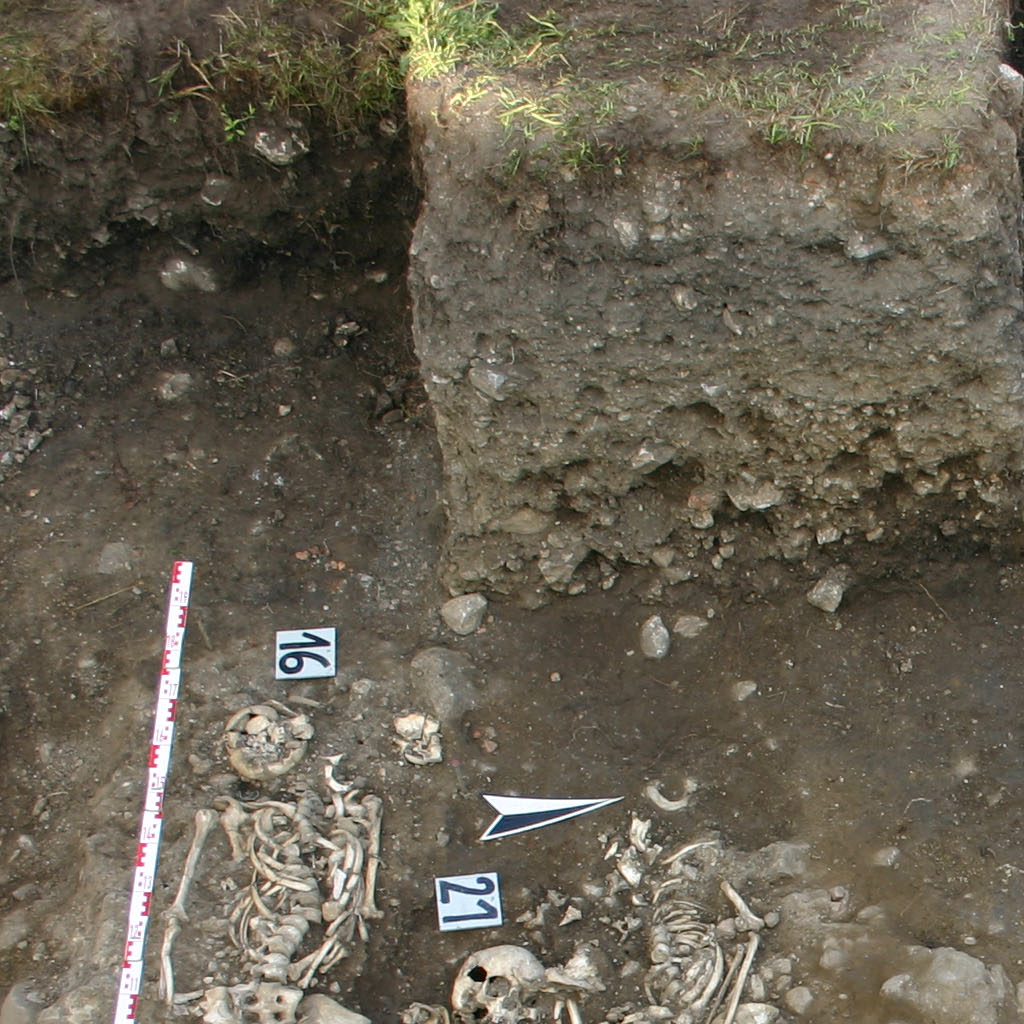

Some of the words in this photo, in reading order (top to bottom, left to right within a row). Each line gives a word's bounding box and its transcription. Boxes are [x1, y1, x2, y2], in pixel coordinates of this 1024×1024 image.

[279, 632, 330, 674] 16
[169, 683, 178, 696] 17
[440, 877, 497, 922] 21
[130, 977, 138, 991] 11
